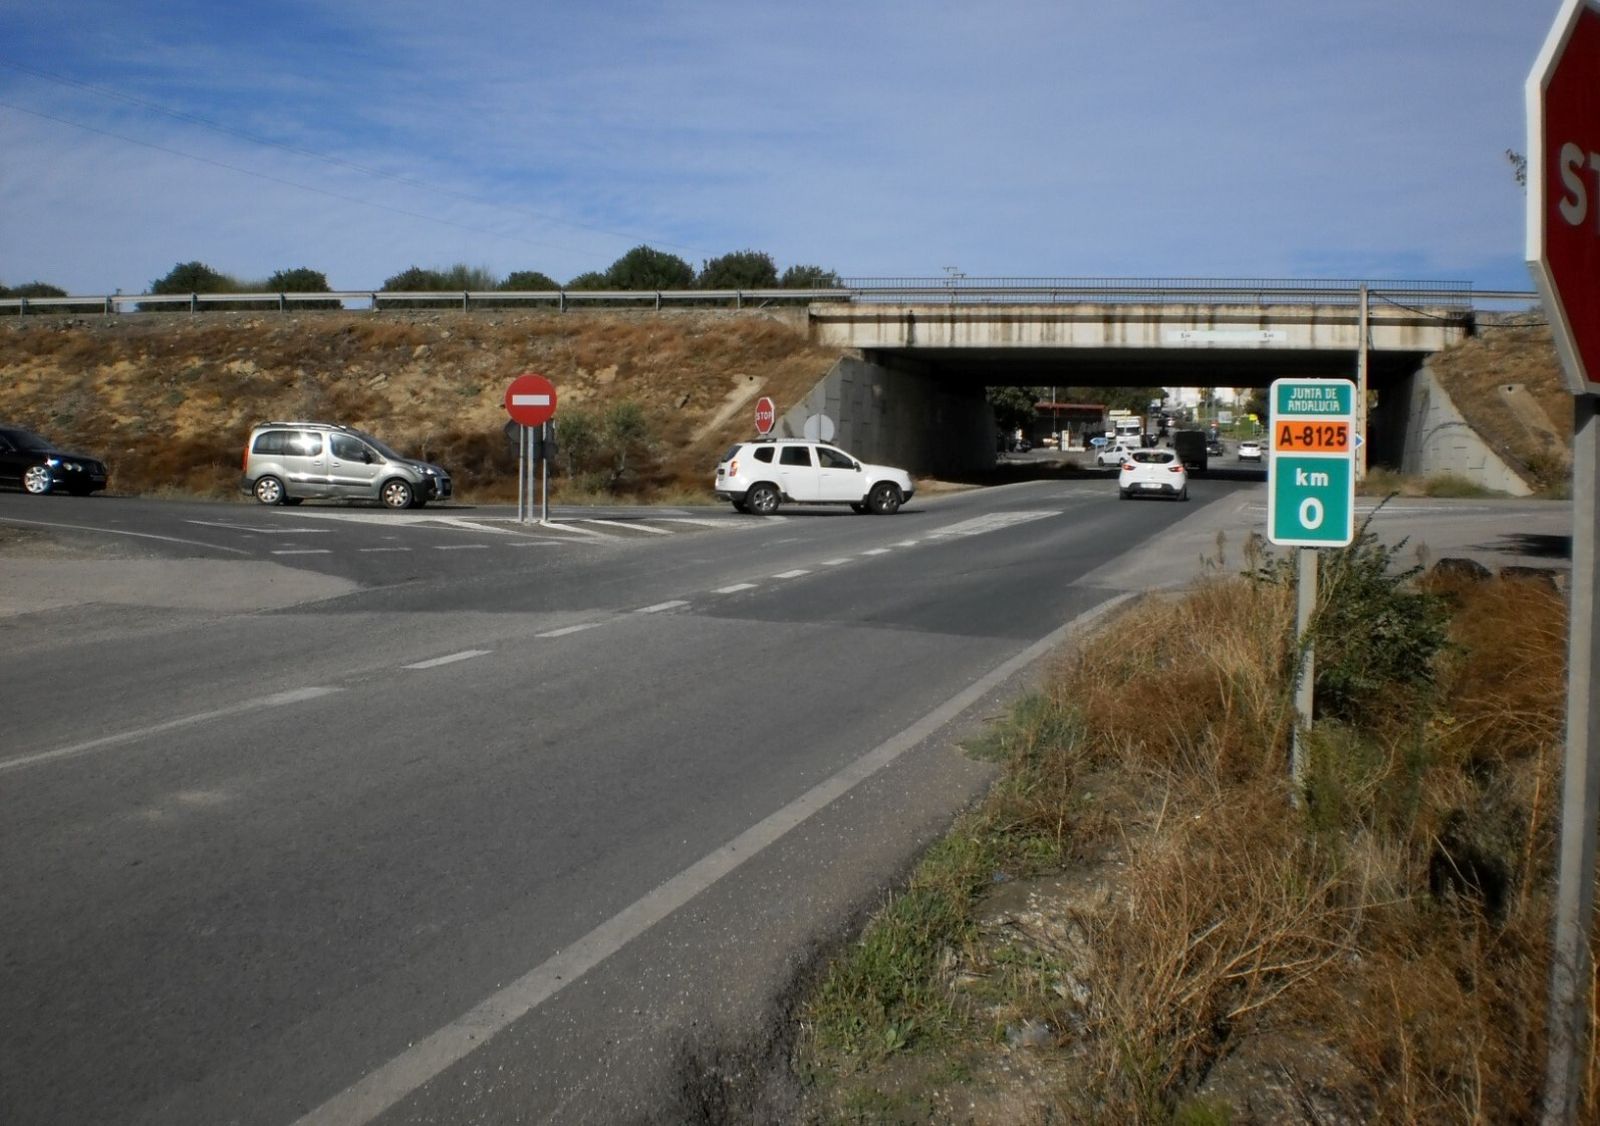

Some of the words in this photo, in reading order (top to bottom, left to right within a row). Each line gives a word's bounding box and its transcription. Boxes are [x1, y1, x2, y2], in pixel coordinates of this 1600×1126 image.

[1290, 387, 1322, 399] JUNTA
[1325, 388, 1337, 399] DE
[756, 411, 772, 420] STOP
[1280, 425, 1347, 447] A-8125
[1295, 467, 1329, 487] km
[1298, 497, 1324, 530] 0
